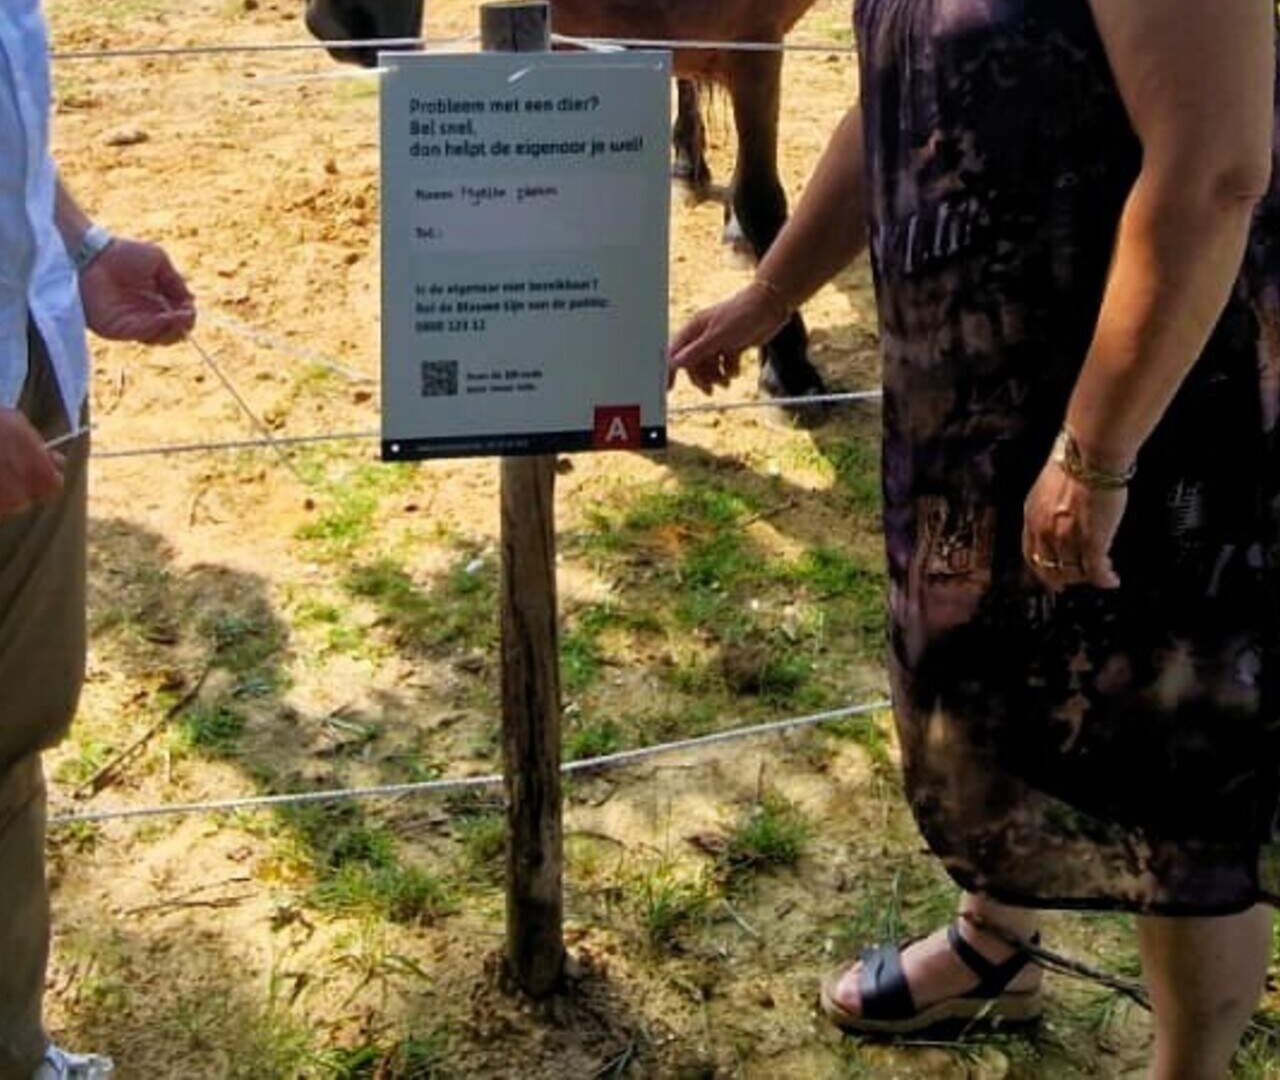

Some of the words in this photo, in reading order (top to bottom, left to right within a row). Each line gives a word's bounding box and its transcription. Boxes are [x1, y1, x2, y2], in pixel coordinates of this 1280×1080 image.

[409, 97, 485, 114] Probleem
[490, 98, 519, 112] met
[524, 99, 554, 112] een
[557, 95, 600, 112] dier?
[409, 119, 436, 136] Bel
[409, 140, 441, 157] dan
[445, 139, 485, 158] helpt
[490, 139, 511, 156] de
[516, 140, 586, 159] eigenaar
[591, 137, 605, 158] je
[610, 135, 644, 153] wel!
[606, 417, 628, 442] A
